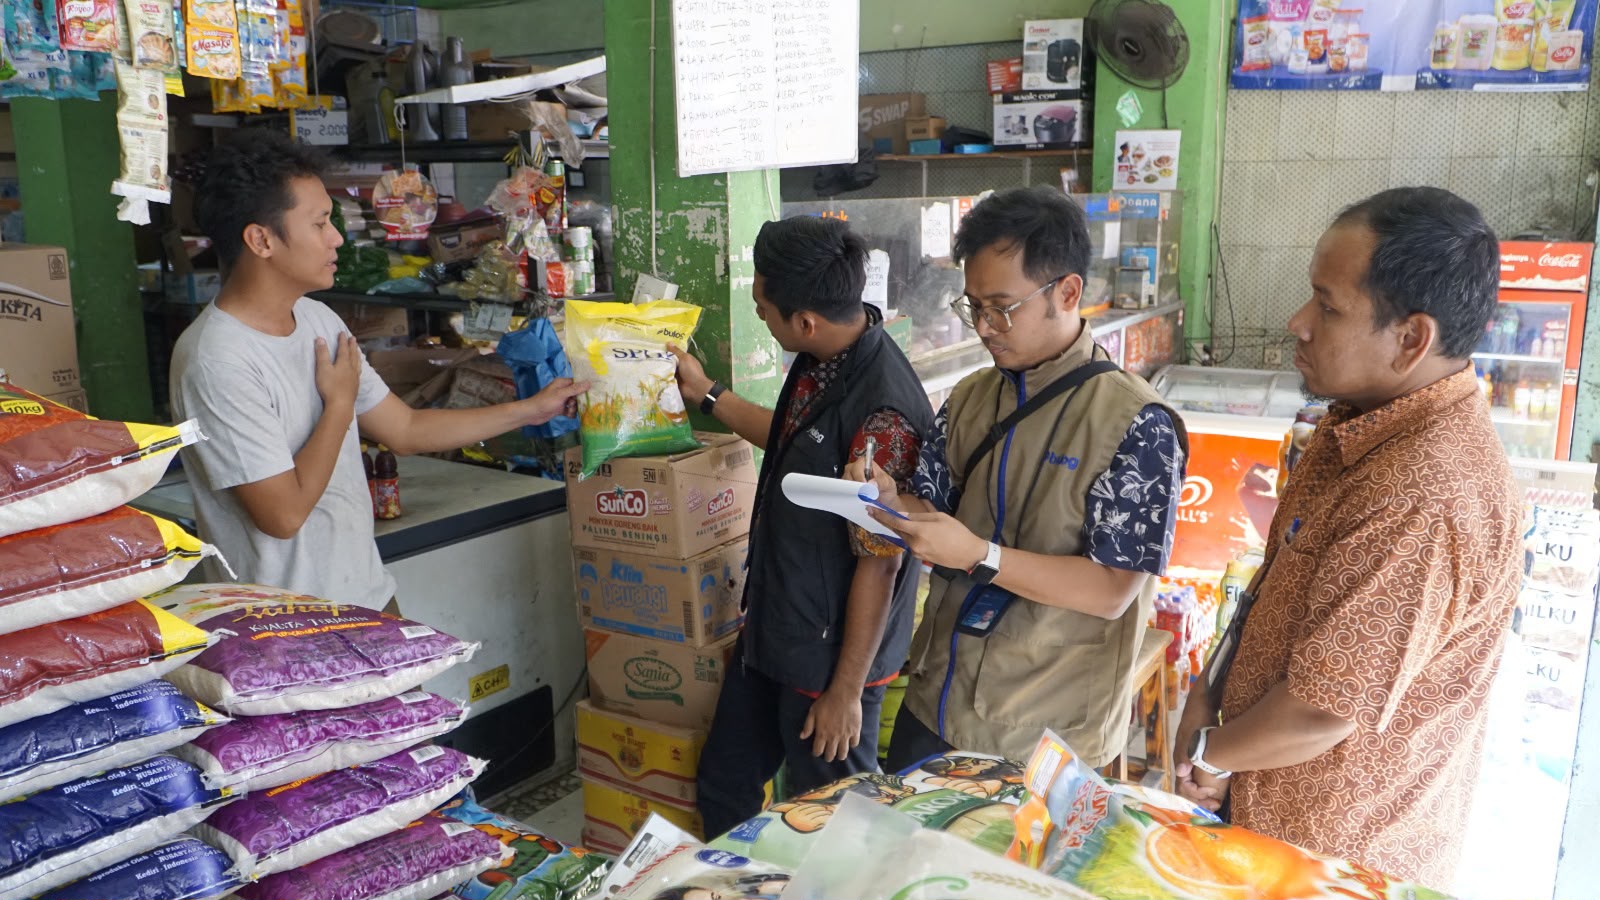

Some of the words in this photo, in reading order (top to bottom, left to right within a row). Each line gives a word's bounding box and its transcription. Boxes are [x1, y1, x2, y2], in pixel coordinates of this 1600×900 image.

[192, 39, 231, 51] Masako
[873, 101, 909, 126] SWAP
[297, 126, 311, 138] Rp
[600, 493, 644, 514] SunCo
[709, 493, 734, 514] SunCo
[1176, 508, 1208, 524] LL'S
[582, 524, 617, 536] PALING
[610, 558, 644, 584] Klin
[633, 662, 670, 682] Sania
[110, 687, 159, 703] NUSANTARA
[114, 695, 154, 710] Indonesia
[135, 761, 183, 781] NUSANTARA
[141, 773, 179, 788] Indonesia
[158, 846, 202, 863] NUSANTARA
[134, 867, 160, 880] Kediri
[162, 855, 199, 872] Indonesia
